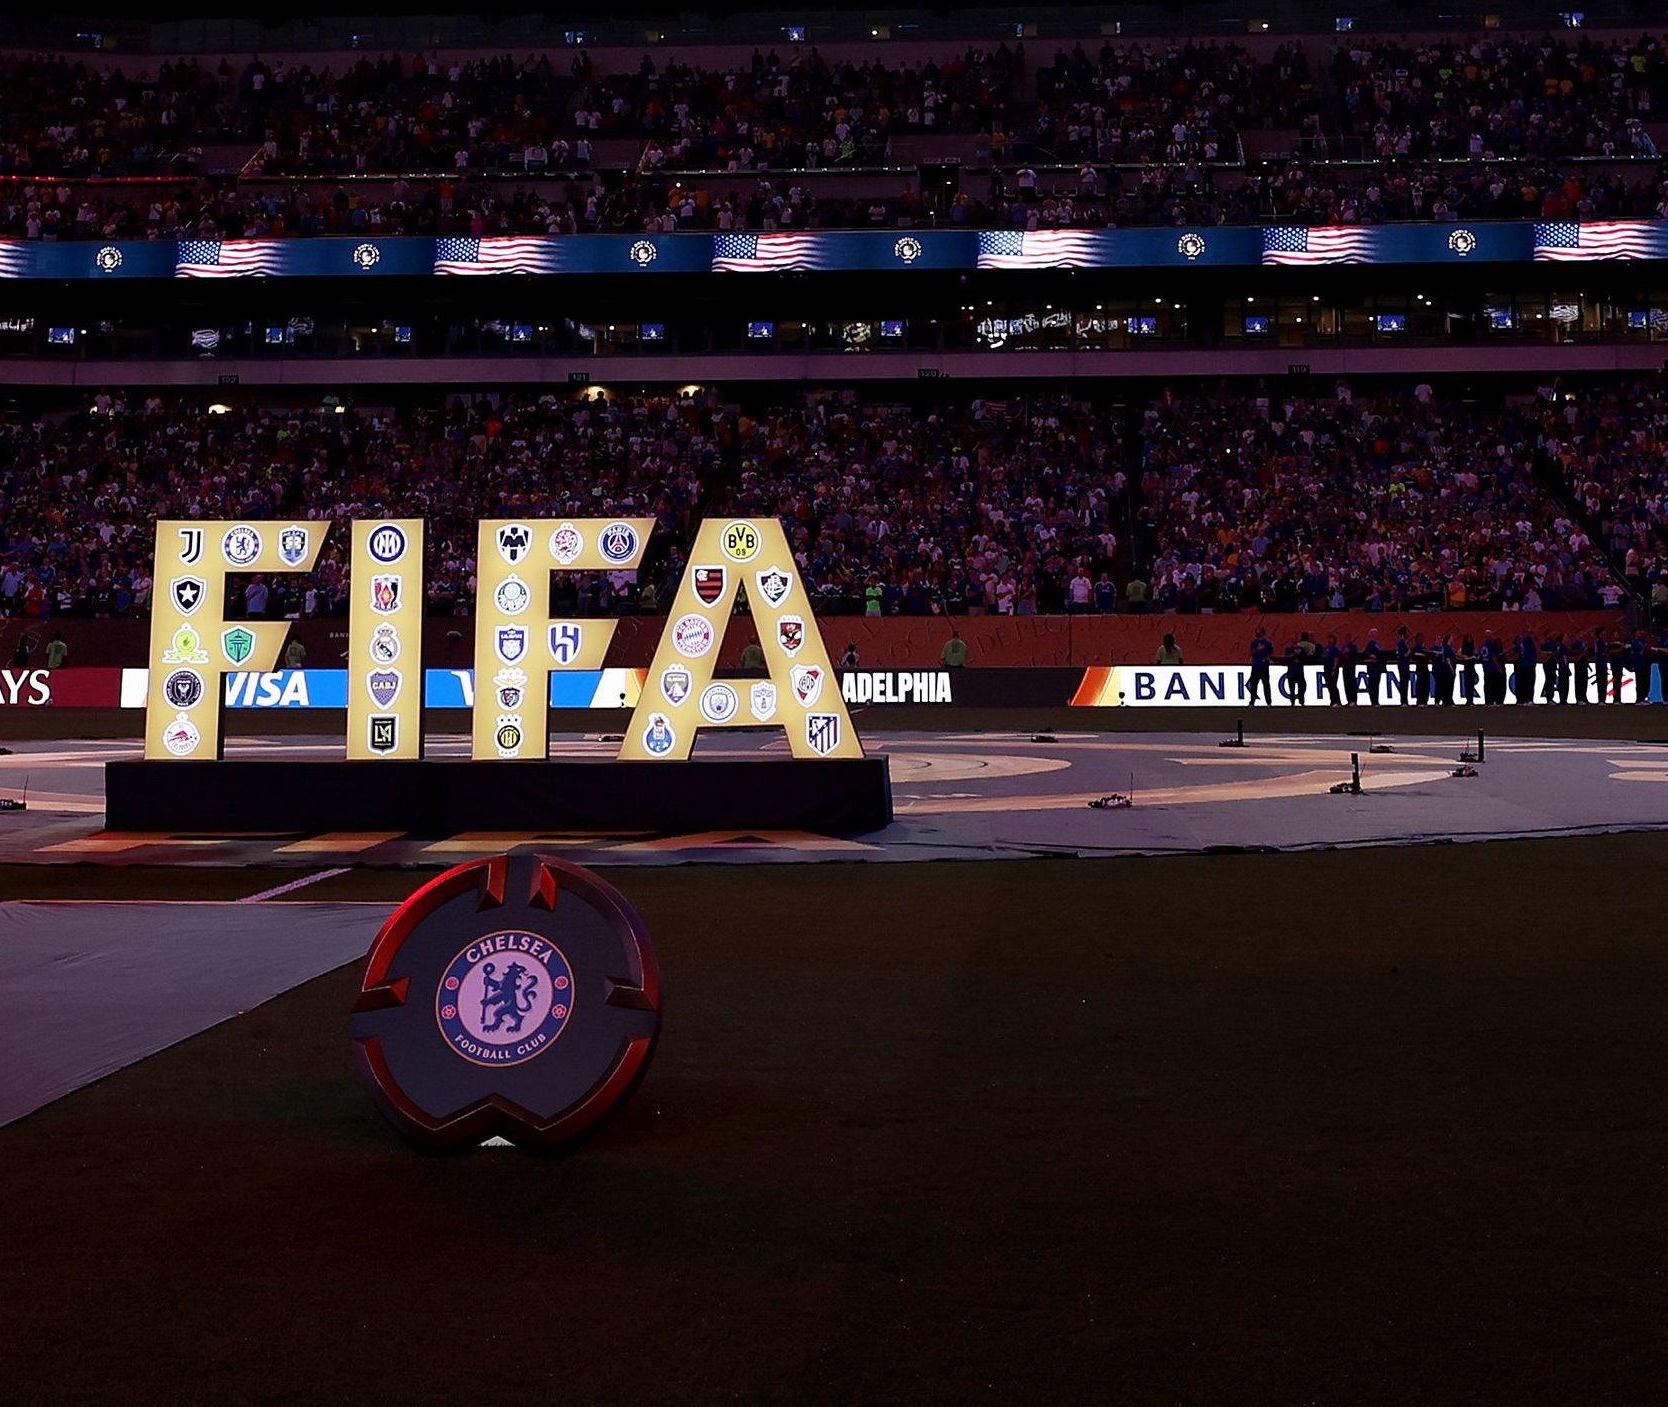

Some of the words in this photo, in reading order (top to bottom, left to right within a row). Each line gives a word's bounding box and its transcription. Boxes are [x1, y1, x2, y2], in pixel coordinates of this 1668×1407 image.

[145, 518, 866, 760] FIFA
[842, 672, 952, 704] ADELPHIA
[466, 935, 553, 963] CHELSEA
[454, 1034, 511, 1059] FOOTBALL
[517, 1033, 546, 1055] CLUB
